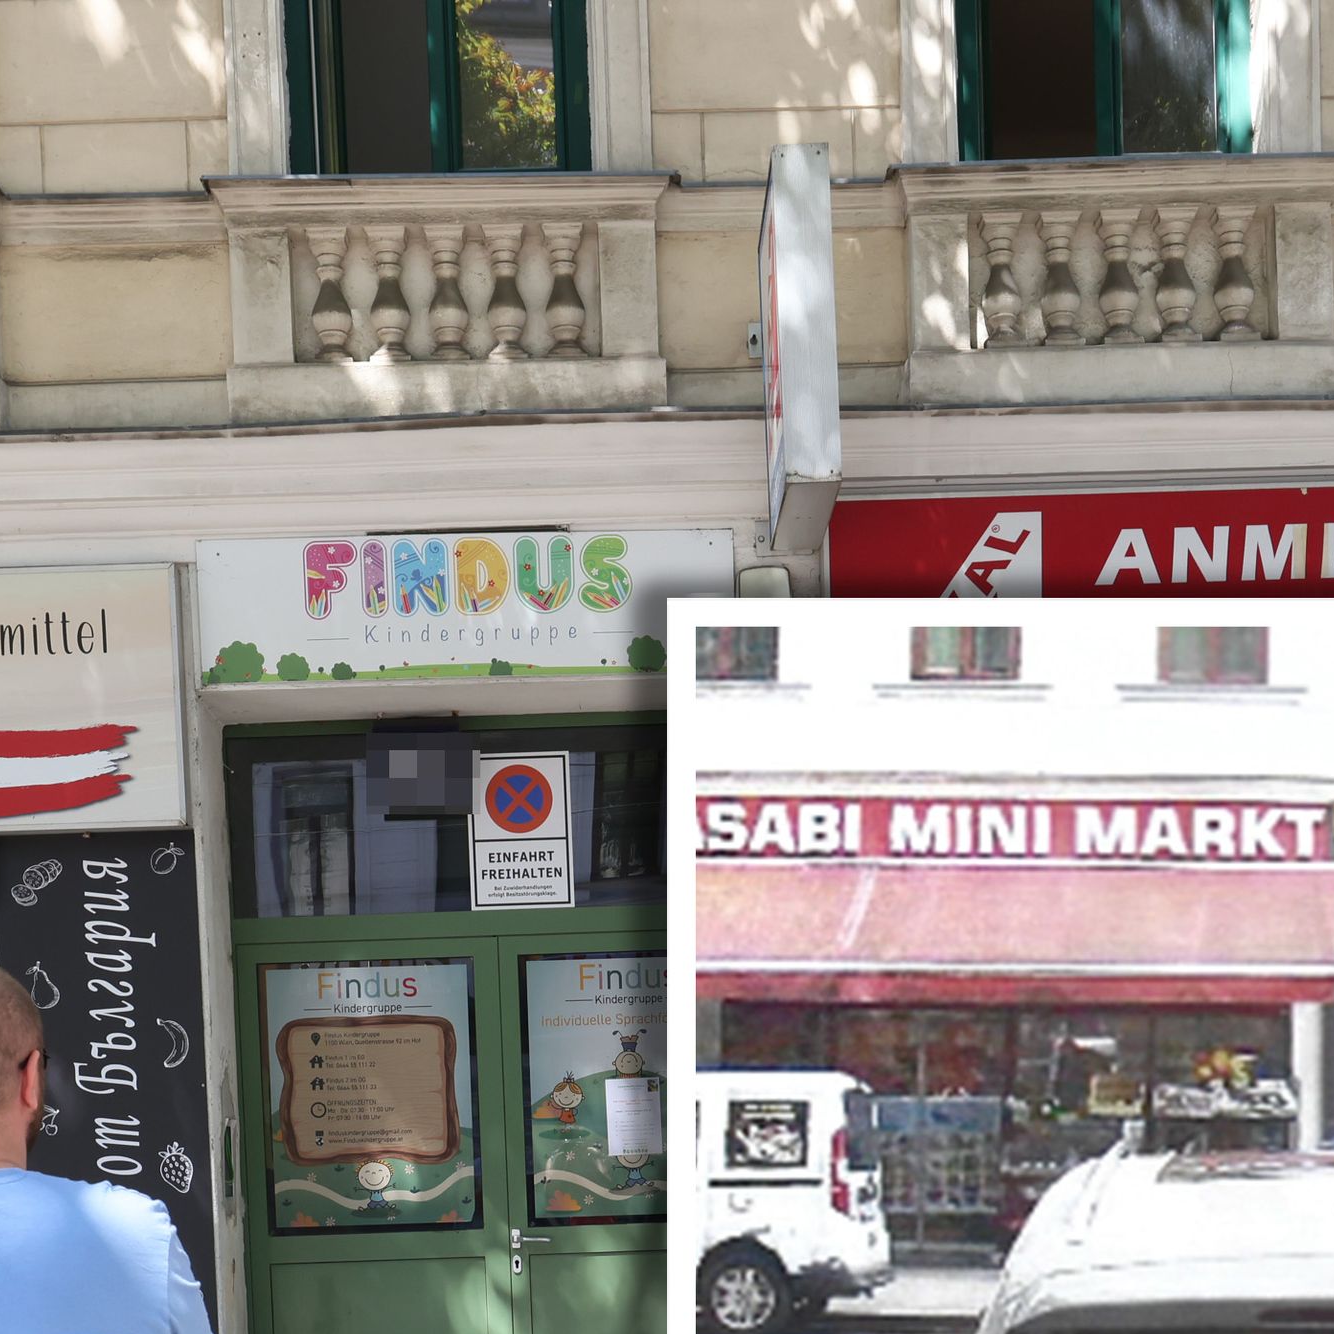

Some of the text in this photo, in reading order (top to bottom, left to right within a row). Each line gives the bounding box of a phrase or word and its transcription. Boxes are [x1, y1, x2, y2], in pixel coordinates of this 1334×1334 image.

[302, 534, 634, 620] FINDUS
[364, 623, 578, 646] Kindergruppe
[696, 802, 1328, 860] SABI MINI MARKT
[488, 850, 555, 863] EINFAHRT
[481, 867, 563, 880] FREIHALTEN
[317, 973, 418, 999] Findus
[333, 1002, 403, 1015] Kindergruppe
[595, 994, 663, 1005] Kindergruppe
[73, 857, 157, 1176] от България
[541, 1014, 611, 1027] Individuelle
